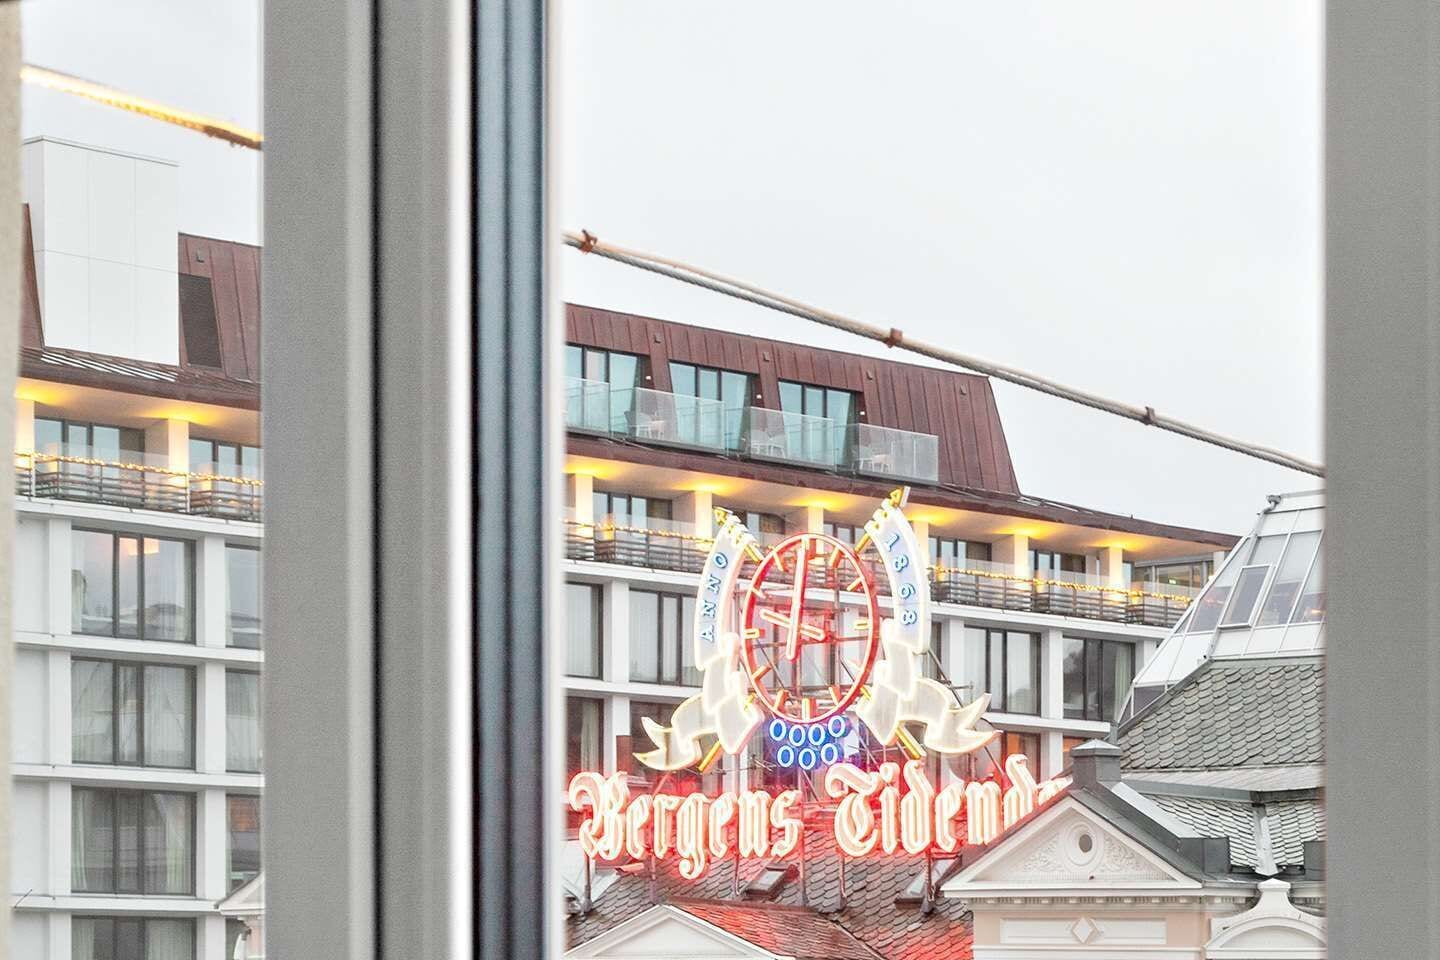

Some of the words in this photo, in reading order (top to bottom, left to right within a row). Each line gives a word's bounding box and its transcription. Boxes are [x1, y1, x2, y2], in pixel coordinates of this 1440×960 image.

[701, 551, 729, 643] ANNO
[885, 533, 919, 626] 1868
[568, 771, 804, 881] Bergens
